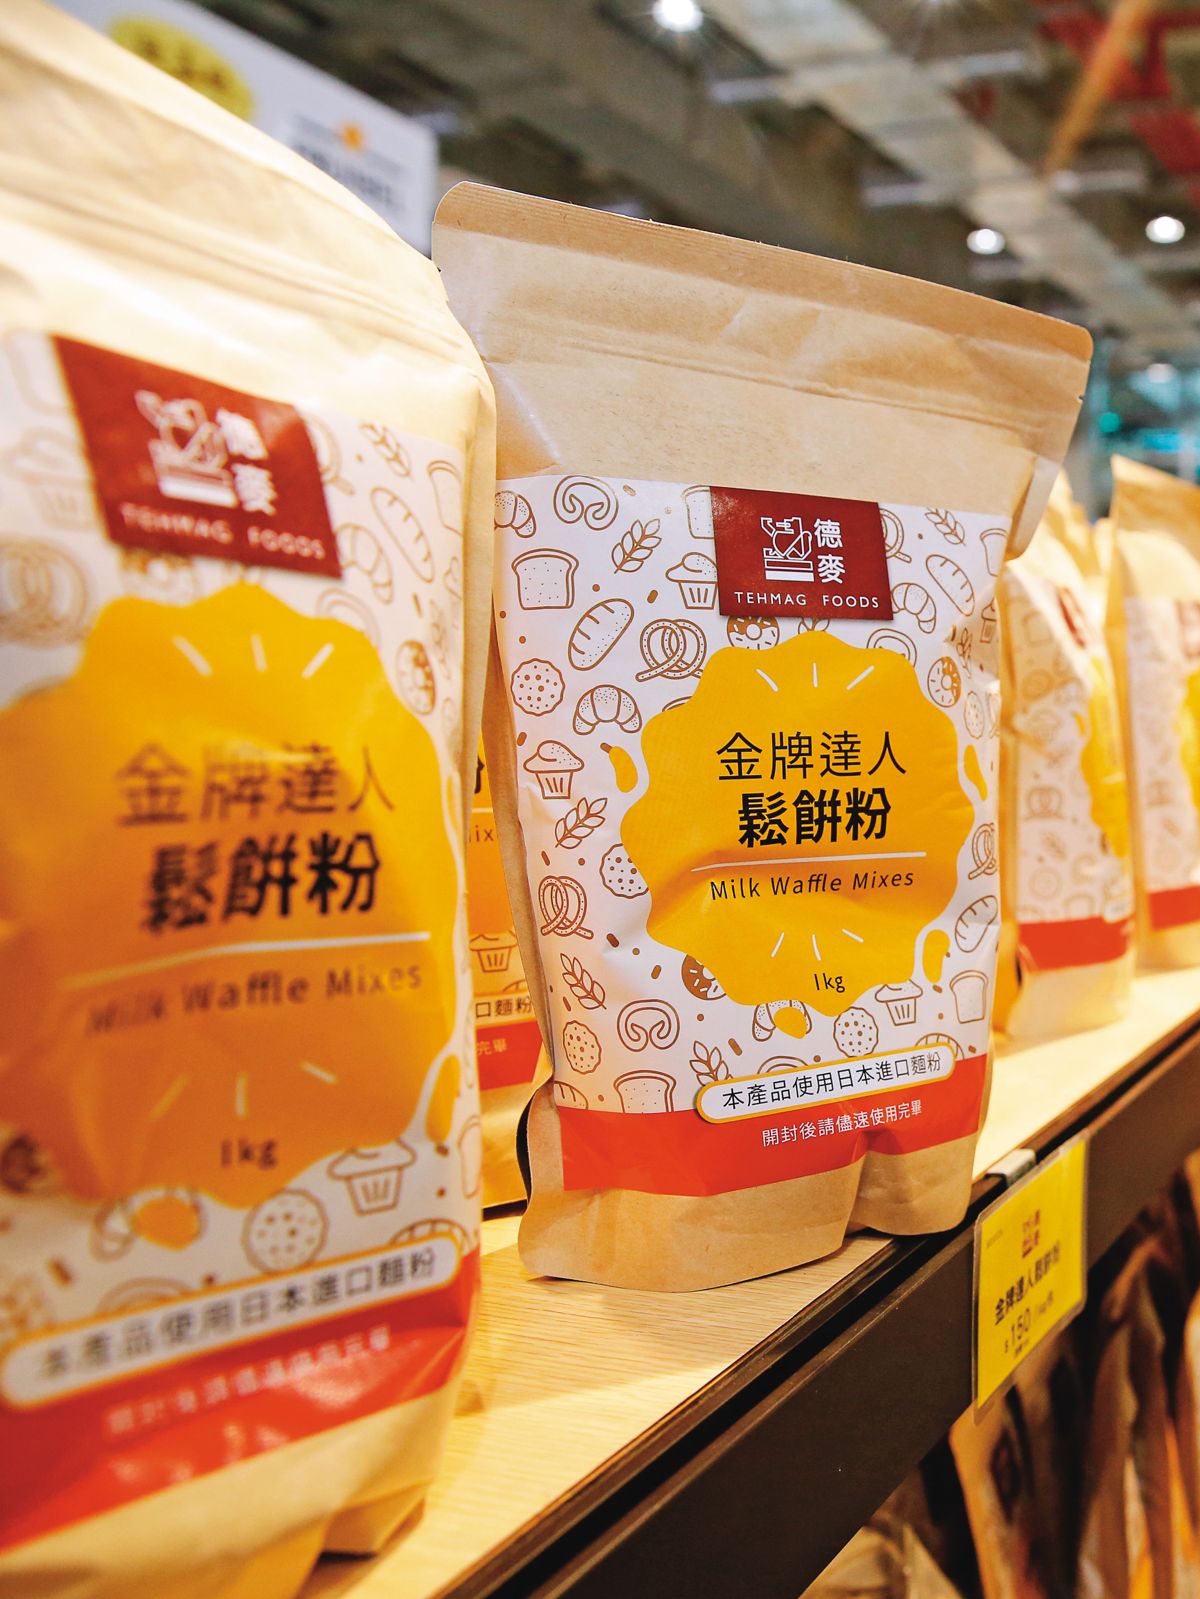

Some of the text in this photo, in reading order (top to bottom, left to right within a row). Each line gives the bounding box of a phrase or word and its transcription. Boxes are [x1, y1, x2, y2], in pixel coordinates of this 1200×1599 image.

[813, 518, 846, 585] 德麥
[734, 591, 880, 609] TEHMAG FOODS
[715, 730, 907, 782] 金牌達人
[737, 787, 892, 849] 鬆餅粉
[140, 831, 381, 935] 鬆餅粉
[710, 870, 914, 901] Milk Waffle Mixes
[182, 968, 310, 1014] Waffle
[325, 963, 423, 998] Mixes
[813, 972, 846, 993] 1kg
[722, 1051, 942, 1111] 本產品使用日本進口麵粉
[761, 1099, 923, 1148] 開封後請儘速使用完畢
